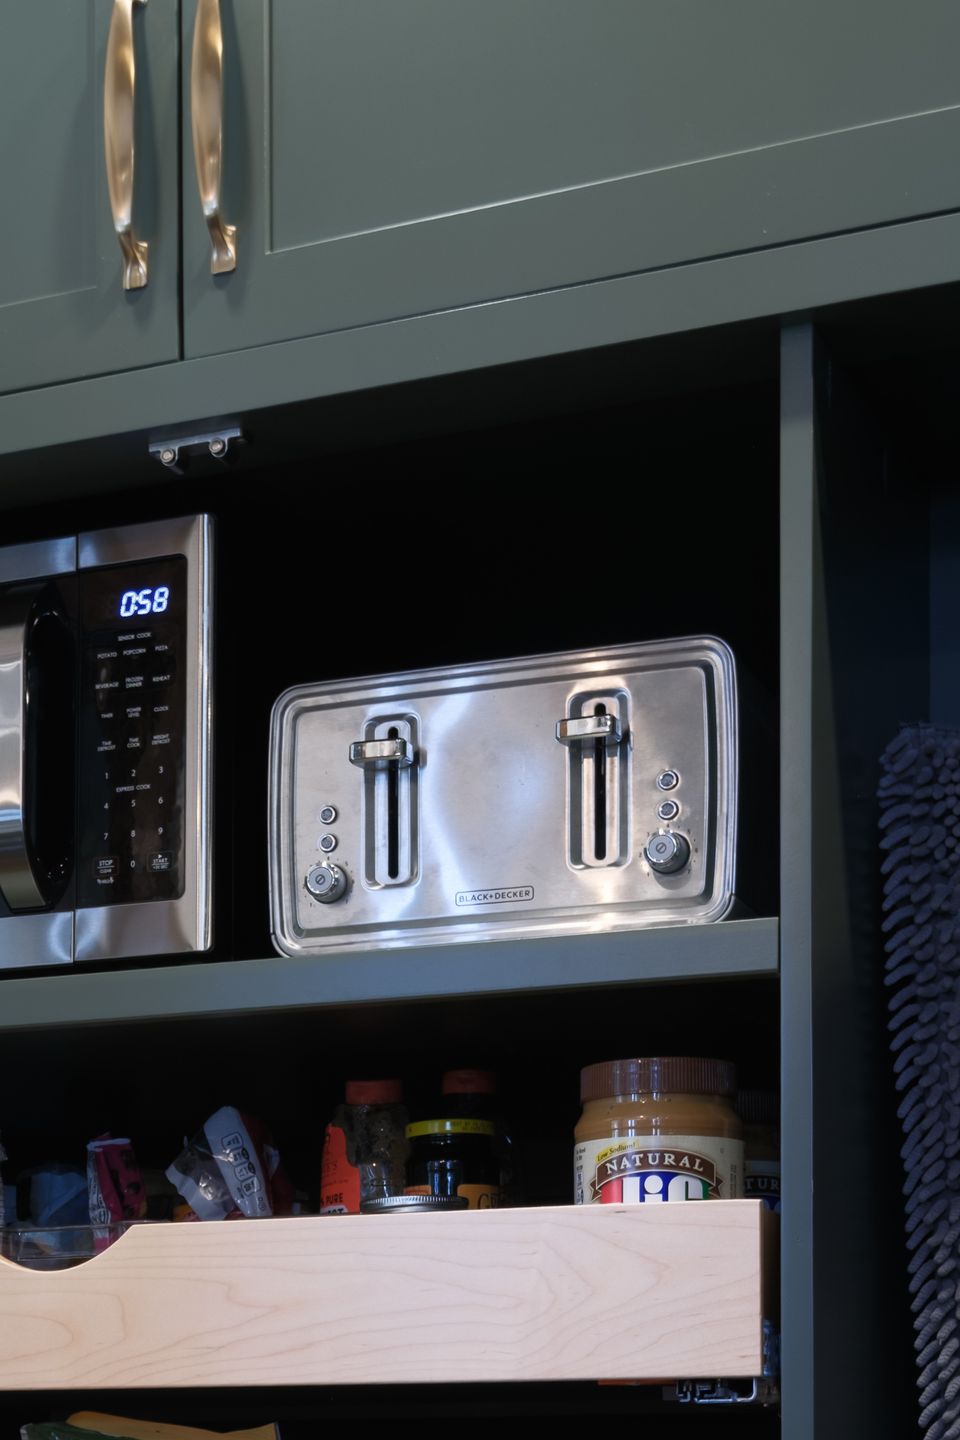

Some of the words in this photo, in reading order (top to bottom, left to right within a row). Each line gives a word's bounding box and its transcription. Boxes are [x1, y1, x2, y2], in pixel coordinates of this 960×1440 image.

[120, 587, 170, 618] 0:58
[97, 651, 117, 660] POTATO
[122, 648, 147, 656] POPCORN
[458, 889, 531, 903] BLACK+DECKER
[605, 1152, 704, 1174] NATURAL
